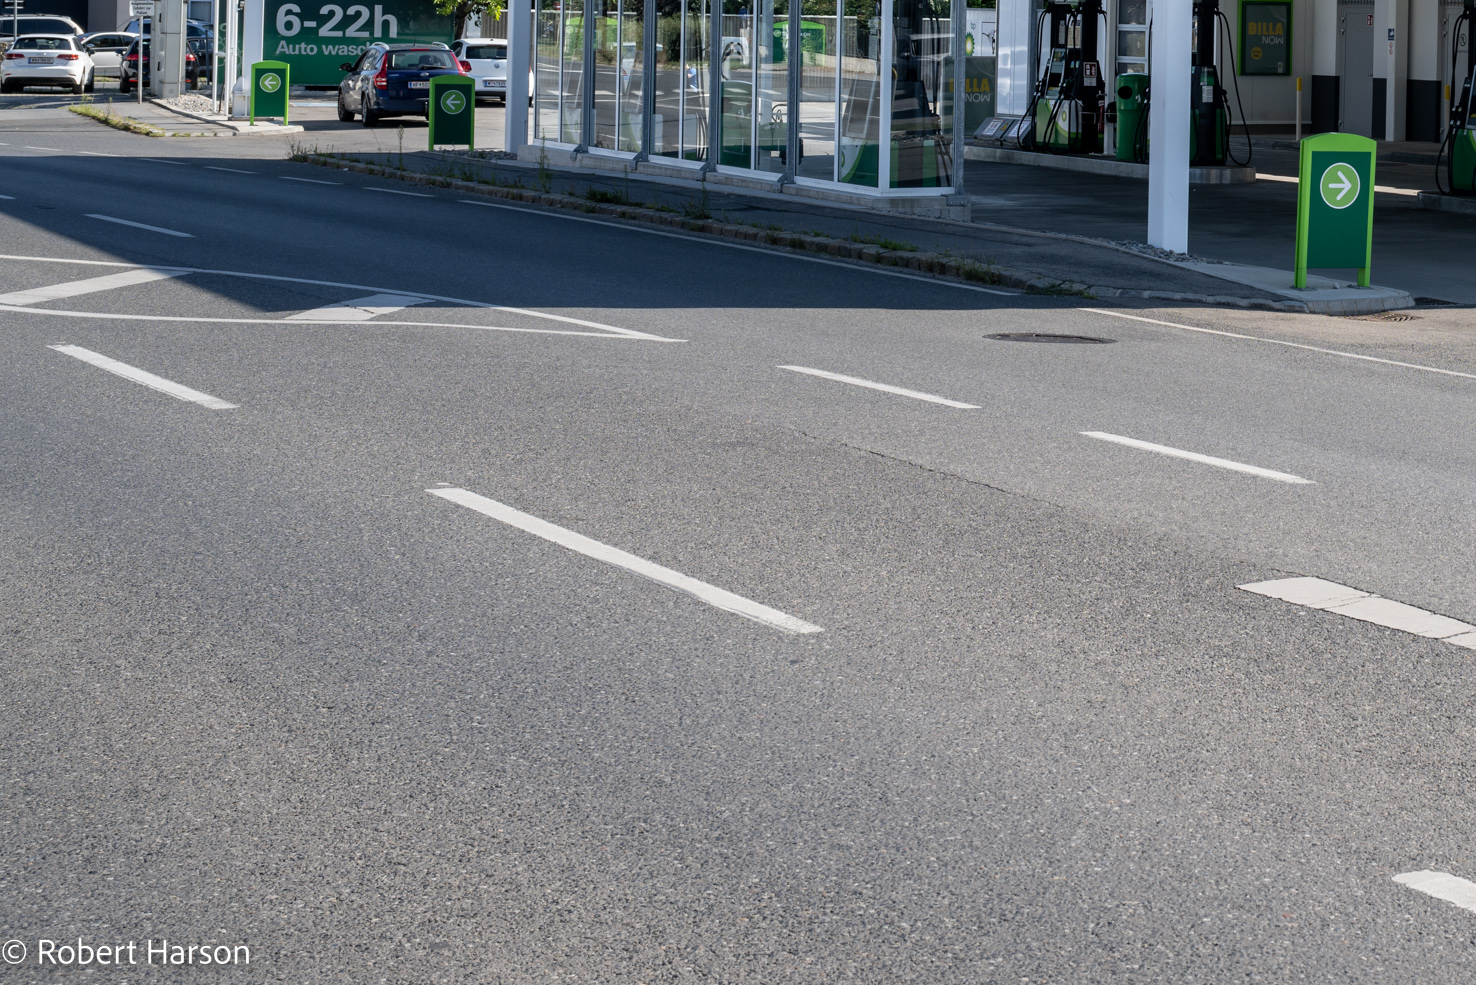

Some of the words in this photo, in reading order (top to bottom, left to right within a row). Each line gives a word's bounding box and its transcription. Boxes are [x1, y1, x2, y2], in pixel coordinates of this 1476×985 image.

[275, 3, 399, 38] 6-22h
[1247, 21, 1284, 36] BILLA
[275, 40, 318, 55] Auto
